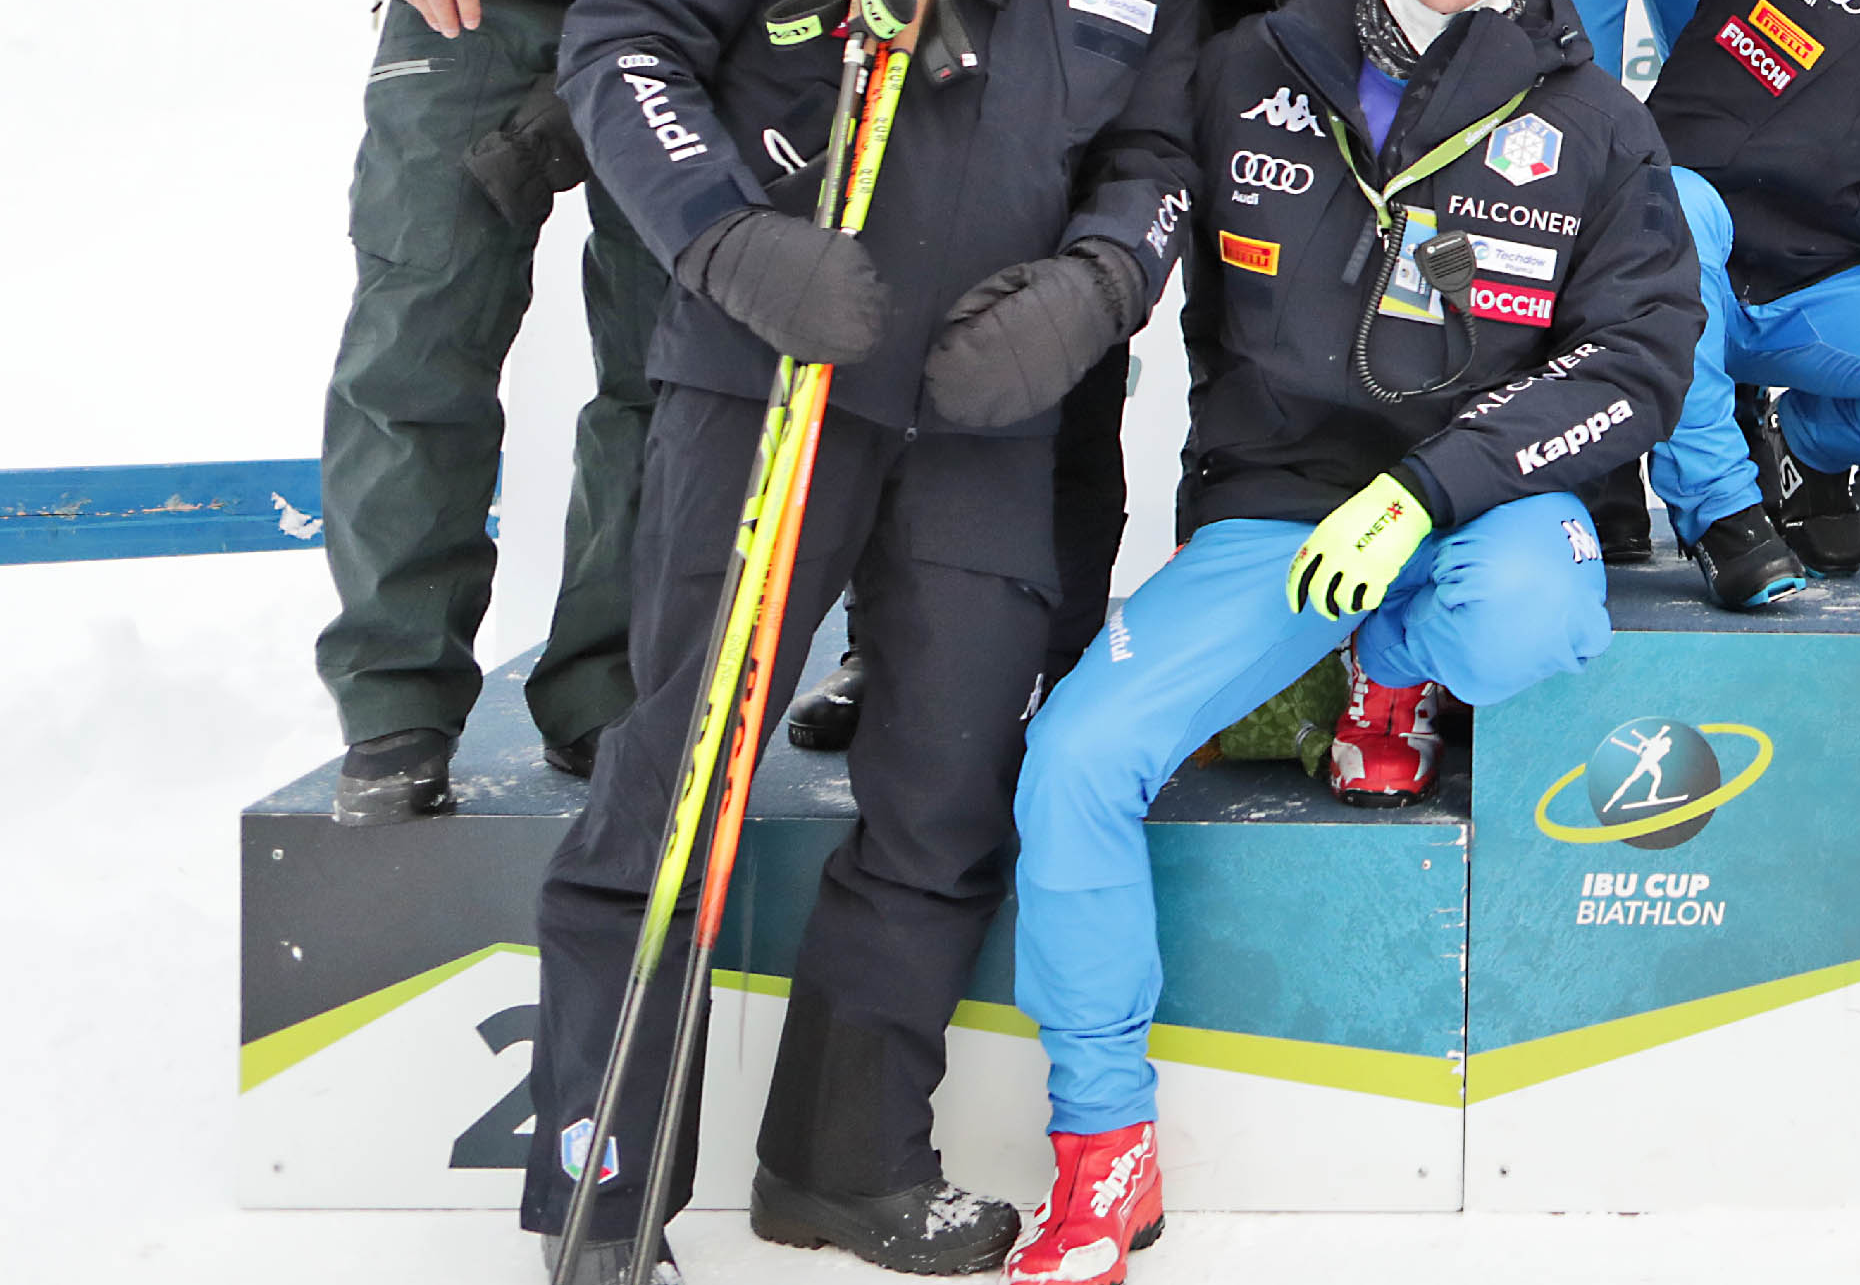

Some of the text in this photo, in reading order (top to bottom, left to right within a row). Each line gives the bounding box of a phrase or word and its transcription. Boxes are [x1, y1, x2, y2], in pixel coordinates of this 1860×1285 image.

[1720, 22, 1791, 90] FIOCCHI
[1756, 7, 1814, 59] PIRELLI
[620, 72, 707, 162] Audi
[1231, 189, 1260, 205] Audi
[1448, 194, 1582, 236] FALCONERI
[1470, 288, 1552, 320] IOCCHI
[1514, 398, 1634, 475] Kappa
[1581, 872, 1711, 898] IBU CUP
[1576, 899, 1726, 927] BIATHLON
[448, 1004, 541, 1170] 2
